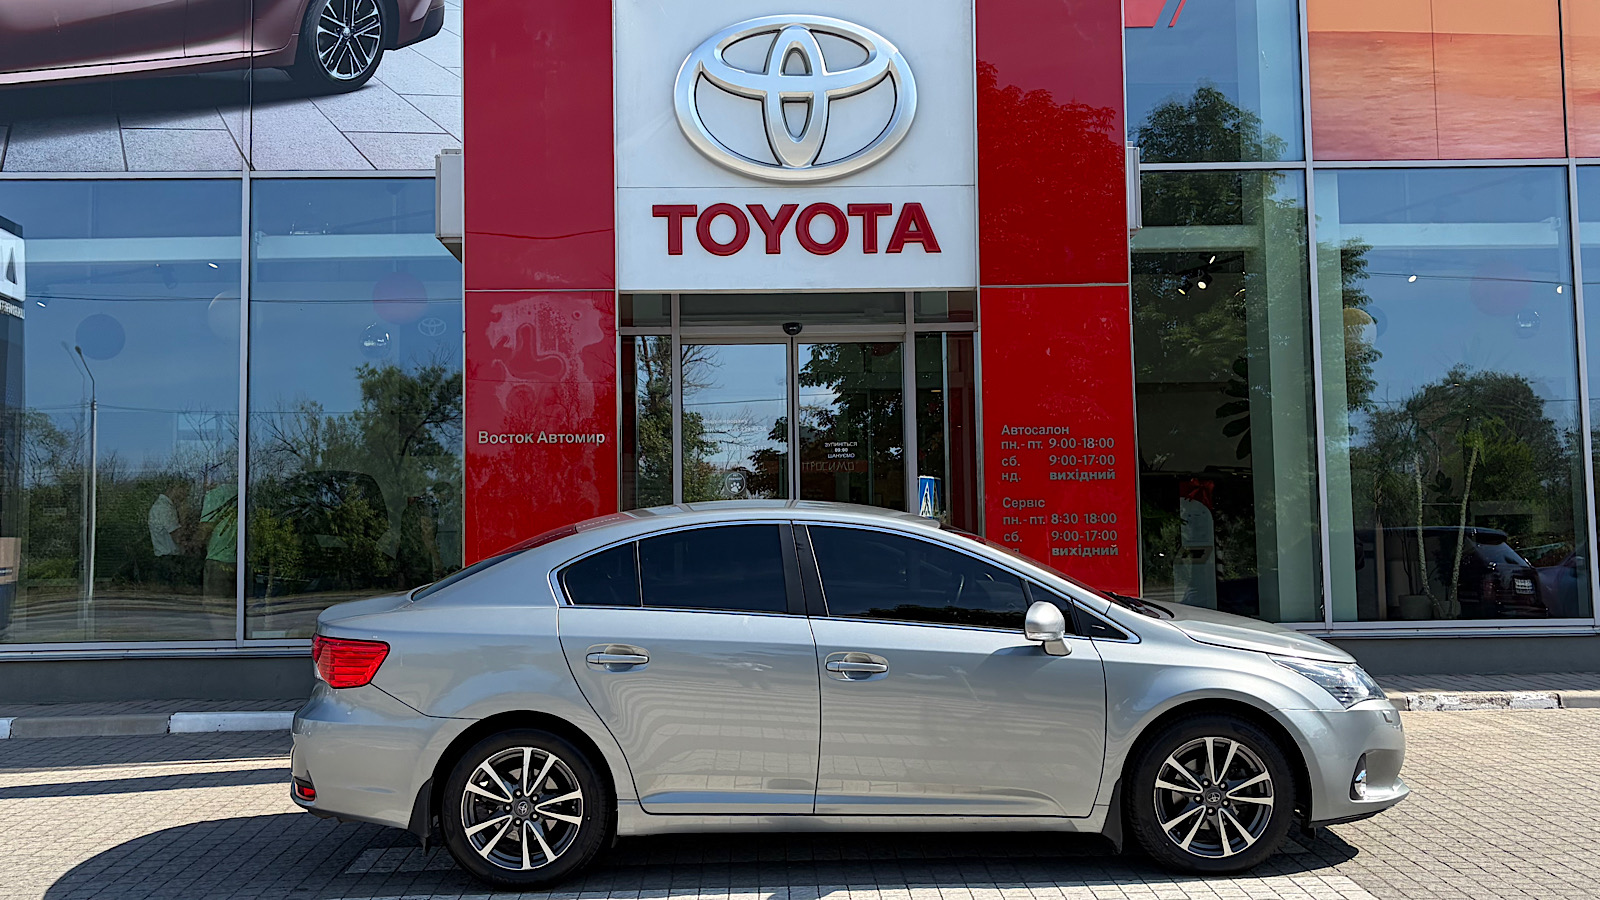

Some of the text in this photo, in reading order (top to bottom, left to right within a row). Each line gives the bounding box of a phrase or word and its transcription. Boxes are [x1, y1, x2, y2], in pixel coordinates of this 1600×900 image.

[652, 202, 942, 256] TOYOTA
[1001, 424, 1070, 435] Автосалон
[478, 430, 605, 446] Восток Автомир
[801, 461, 855, 471] ПРОСИМО
[1001, 454, 1116, 467] сб. 9:00-17:00
[1002, 468, 1116, 482] нд. вихідний
[1002, 497, 1046, 510] Сервіс
[1003, 530, 1118, 542] сб. 9:00-17:00
[1051, 544, 1119, 557] вихідний
